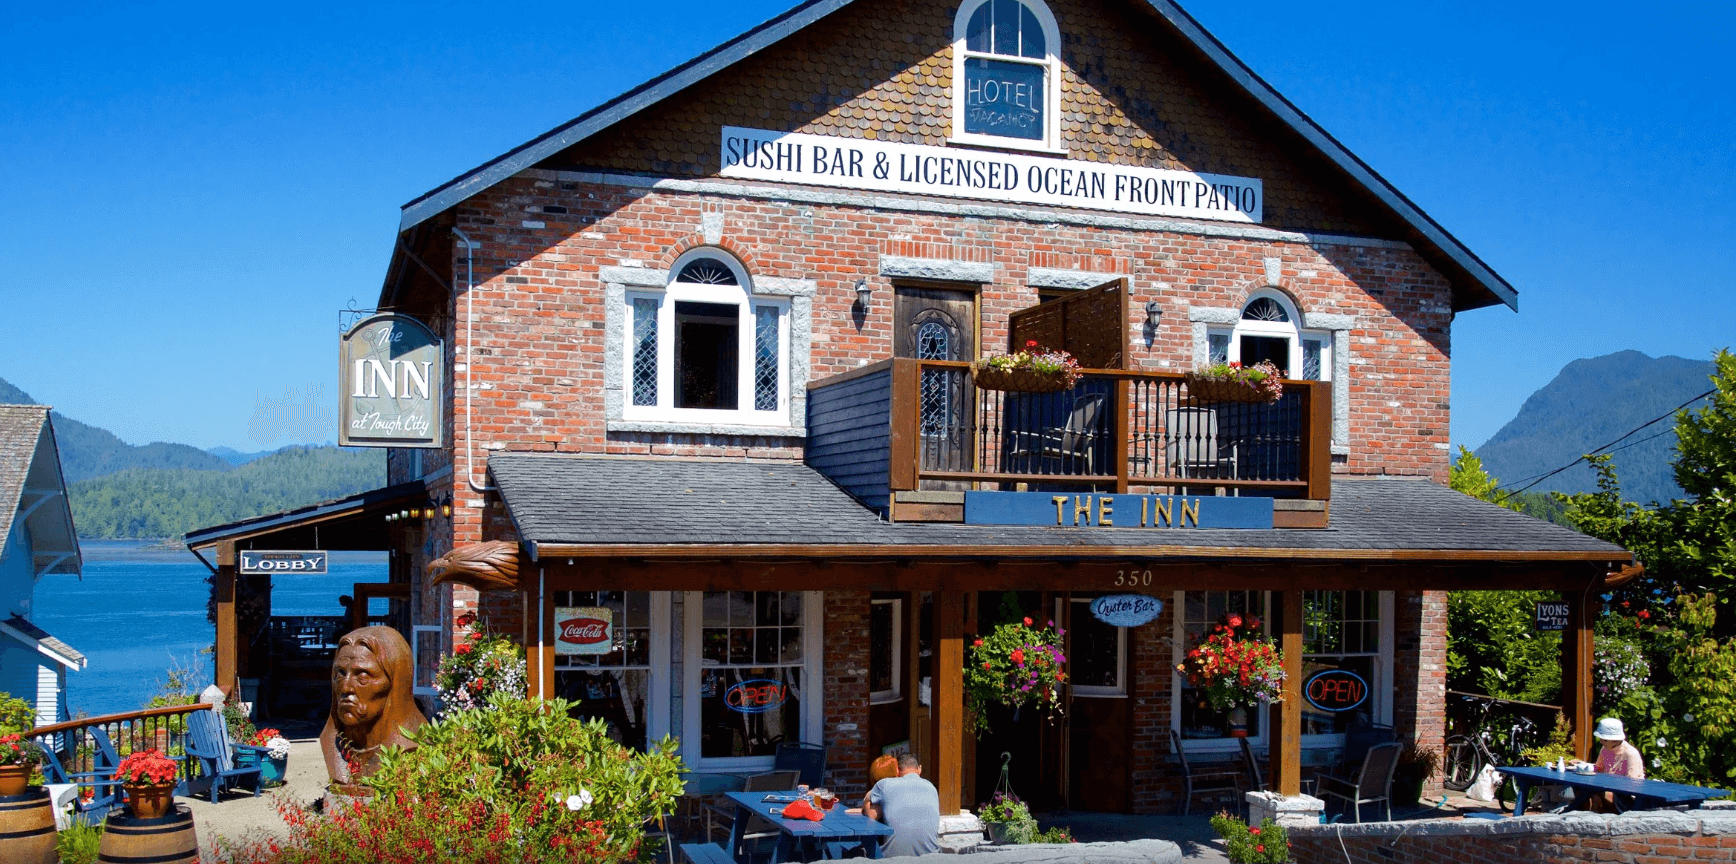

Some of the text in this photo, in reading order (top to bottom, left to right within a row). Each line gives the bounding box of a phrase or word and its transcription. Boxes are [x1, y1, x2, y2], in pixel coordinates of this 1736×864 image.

[967, 78, 1040, 113] HOTEL
[726, 136, 1257, 214] SUSHI BAR & LICENSED OCEAN FRONT PATIO
[378, 324, 403, 347] The
[351, 358, 434, 400] INN
[351, 411, 430, 437] at Tough City
[1052, 495, 1200, 527] THE INN
[243, 556, 323, 570] LOBBY
[1114, 570, 1152, 586] 350
[1097, 599, 1155, 617] Oyster Bar
[1537, 603, 1569, 621] LYONS
[1551, 616, 1568, 625] TEA
[726, 684, 787, 706] OPEN
[1308, 679, 1362, 702] OPEN
